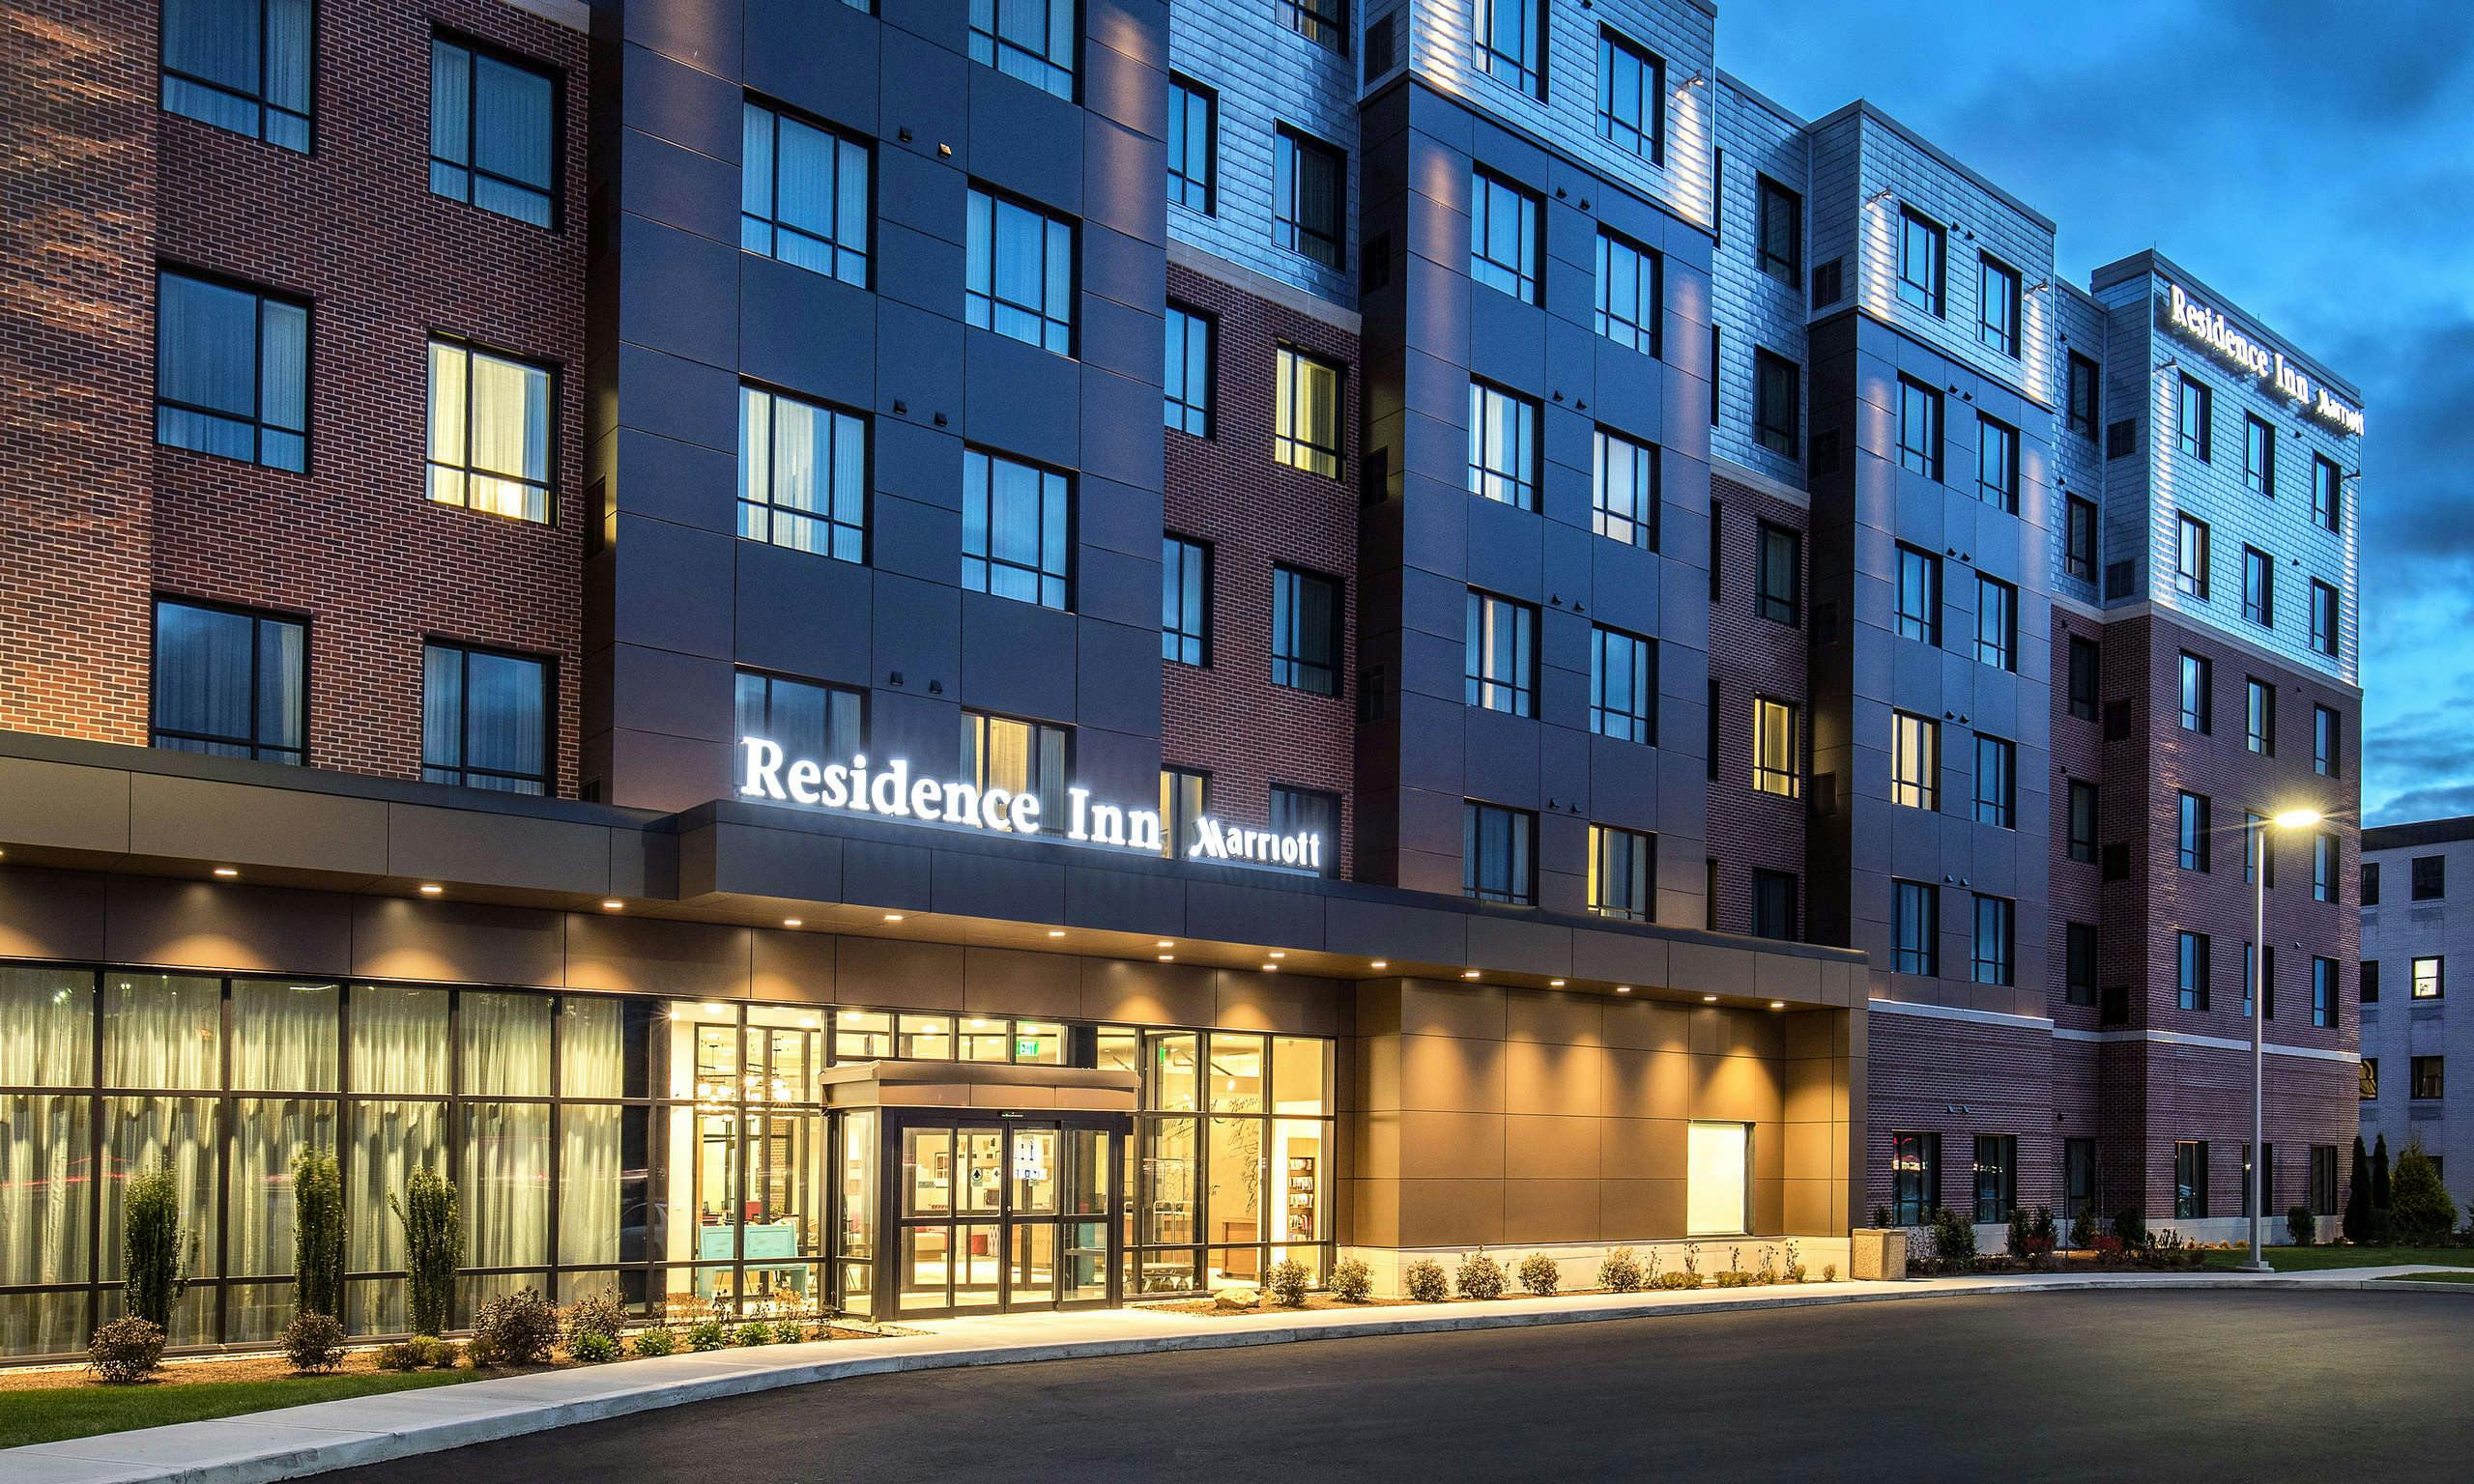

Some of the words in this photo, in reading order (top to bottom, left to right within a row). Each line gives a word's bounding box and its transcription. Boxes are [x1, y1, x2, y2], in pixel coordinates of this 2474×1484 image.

[2170, 284, 2269, 378] Residence
[2273, 353, 2311, 405] Inn
[740, 736, 1041, 834] Residence
[1068, 786, 1163, 851] Inn
[1189, 816, 1321, 868] Marriott
